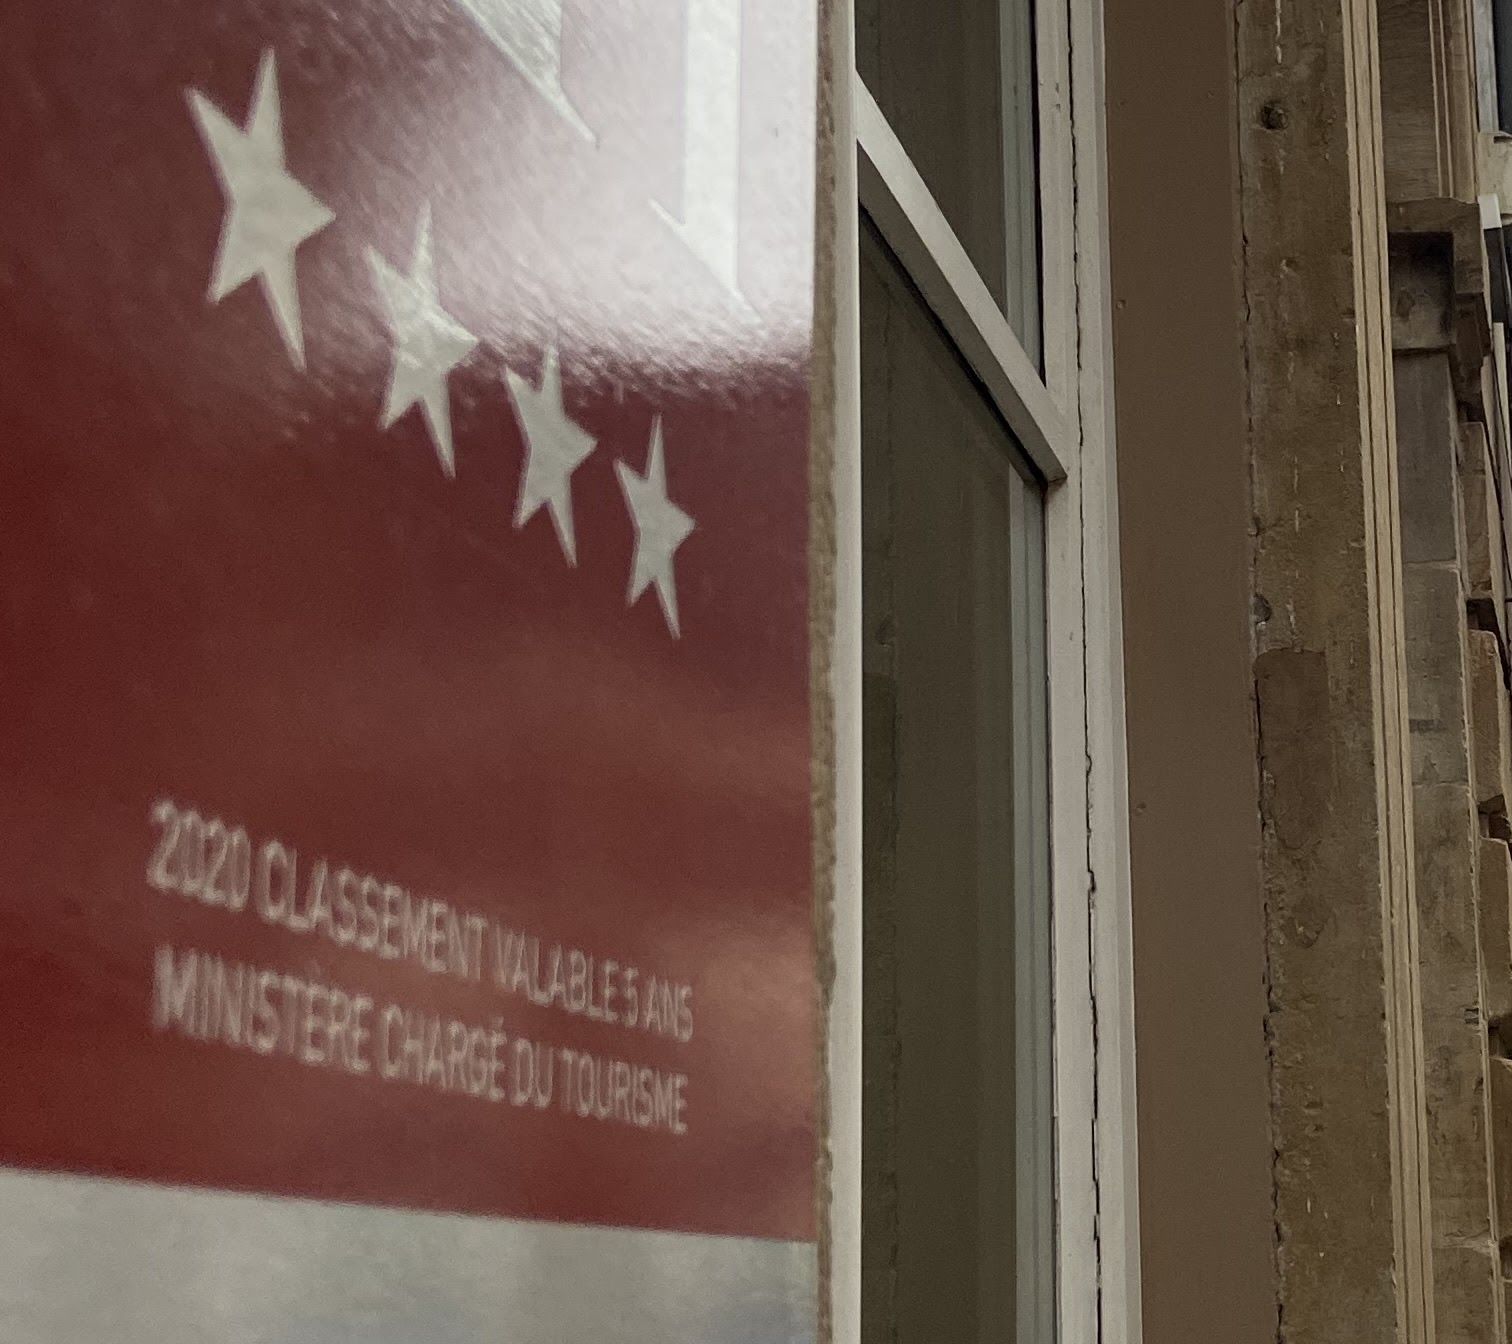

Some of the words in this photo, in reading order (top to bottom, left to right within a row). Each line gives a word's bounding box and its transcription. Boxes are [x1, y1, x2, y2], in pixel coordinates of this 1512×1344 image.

[148, 798, 251, 912] 2020
[253, 839, 488, 982] CLASSEMENT
[494, 921, 619, 1023] VALABLE
[622, 965, 639, 1028] 5
[644, 972, 693, 1043] ANS
[152, 942, 374, 1072] MINISTÈRE
[378, 1003, 506, 1103] CHARGÉ
[510, 1036, 553, 1109] DU
[558, 1047, 688, 1134] TOURISME
